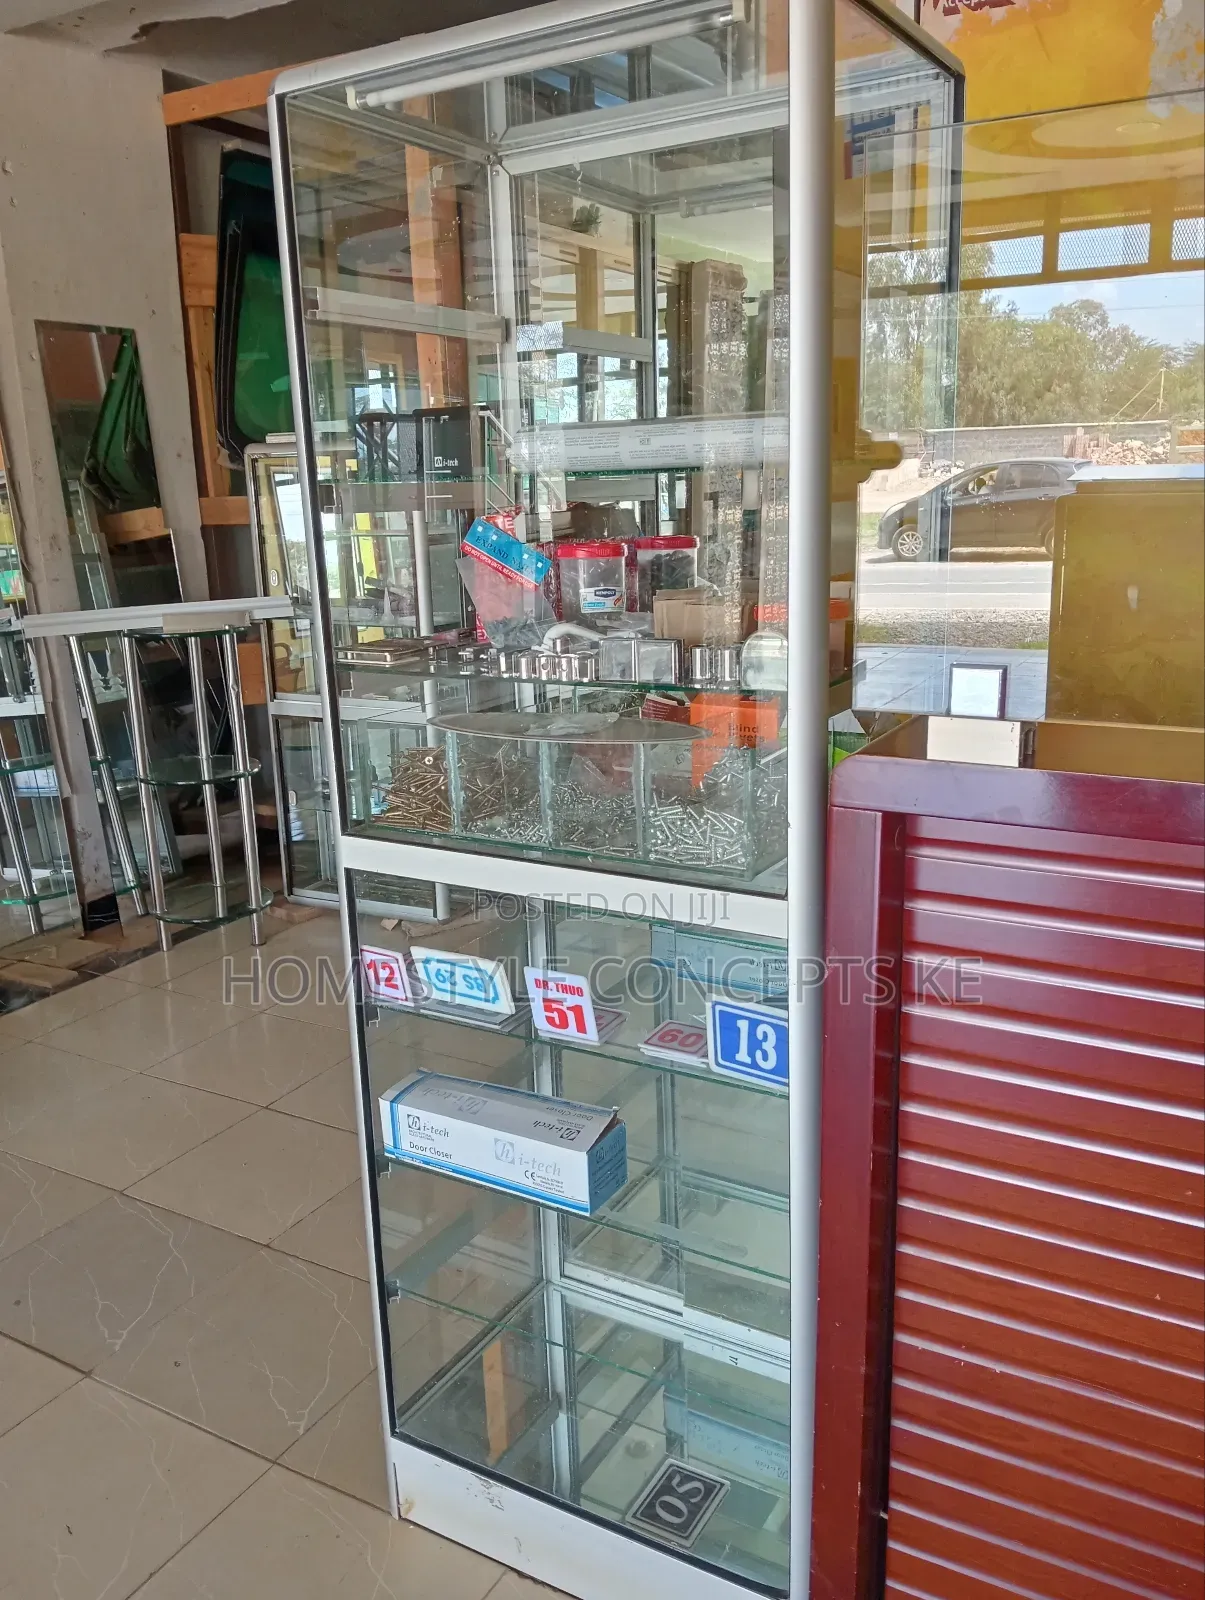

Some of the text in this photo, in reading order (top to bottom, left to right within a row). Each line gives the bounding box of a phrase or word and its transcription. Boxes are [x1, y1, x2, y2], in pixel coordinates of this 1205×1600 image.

[475, 536, 509, 559] EXPAND
[366, 958, 398, 990] 12
[534, 978, 553, 992] DR.
[542, 998, 588, 1034] 51
[658, 1028, 704, 1048] 60
[735, 1020, 778, 1071] 13
[422, 1122, 450, 1138] i-tech
[533, 1120, 562, 1132] i-tech
[409, 1142, 452, 1160] Door Closer
[519, 1153, 561, 1177] i-tech
